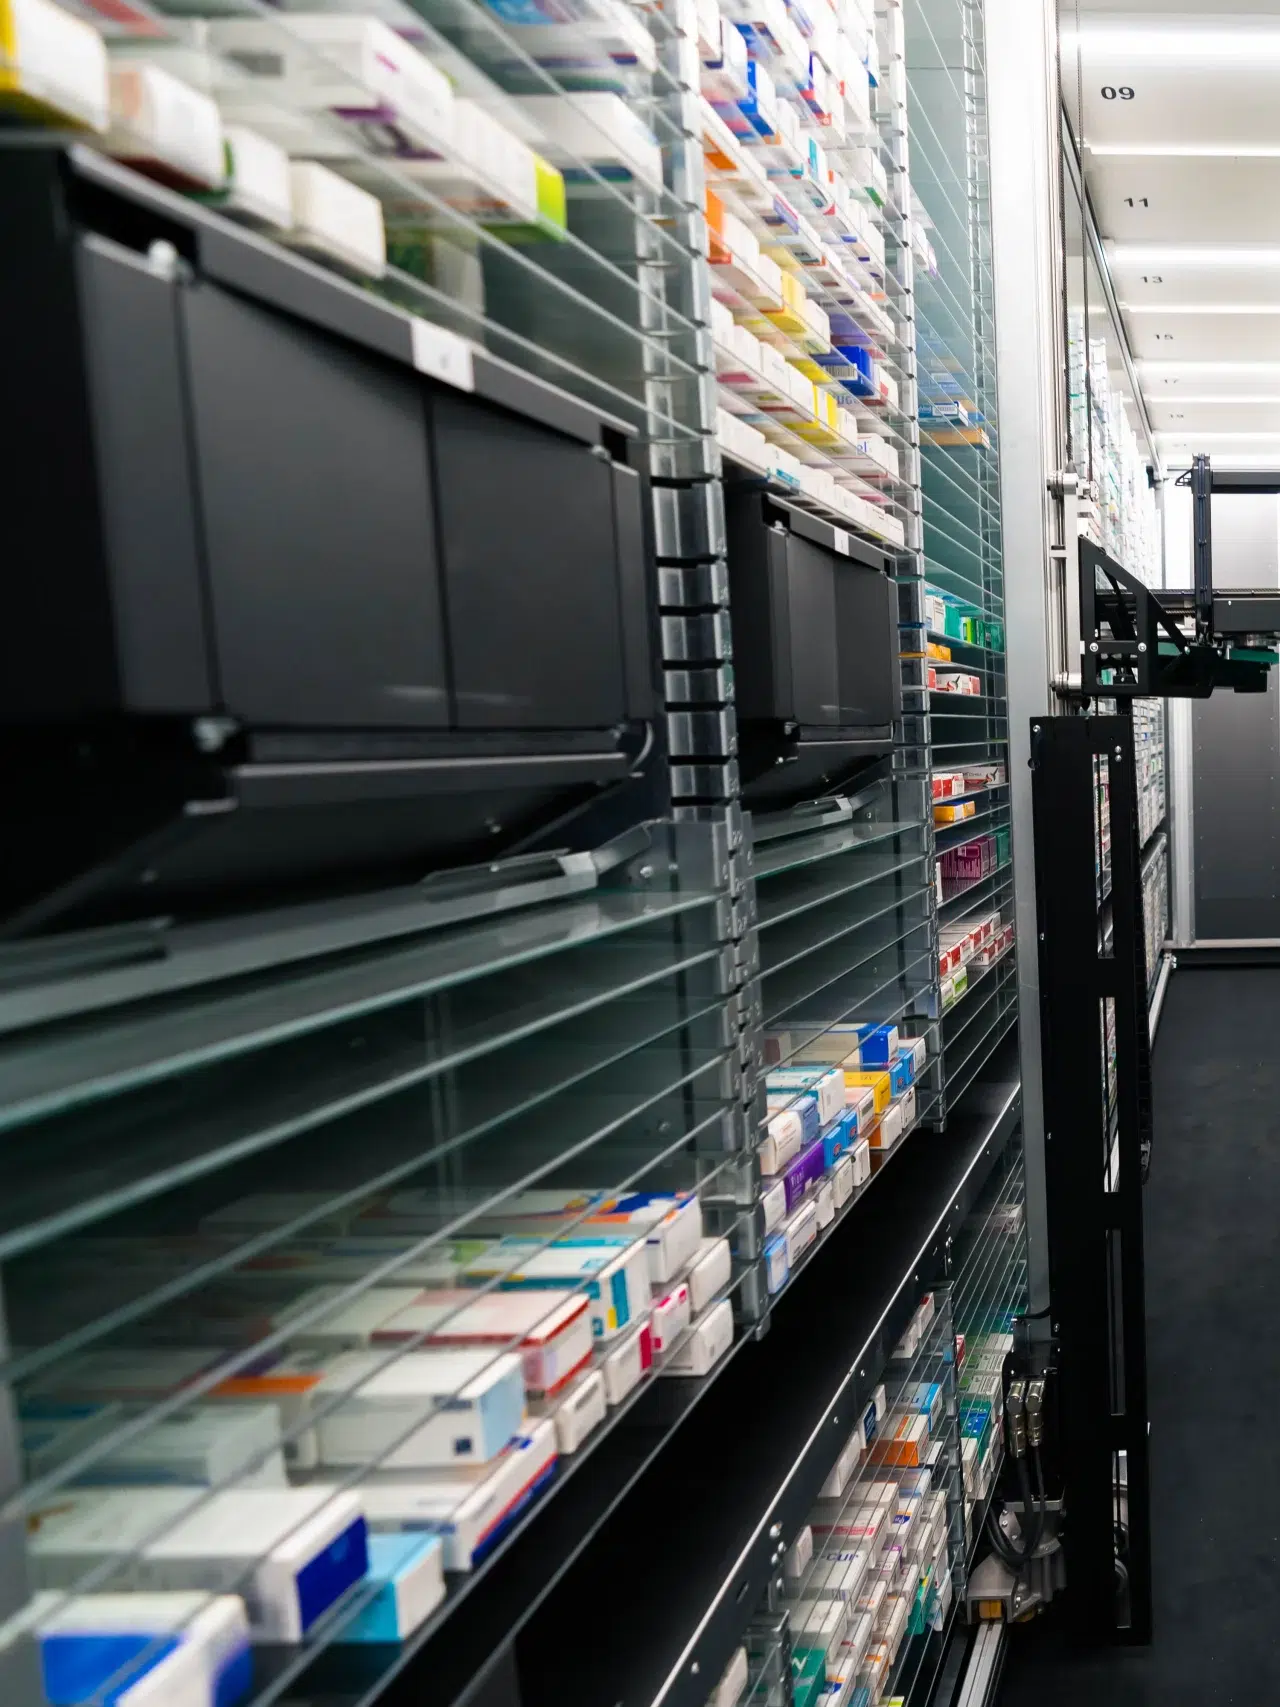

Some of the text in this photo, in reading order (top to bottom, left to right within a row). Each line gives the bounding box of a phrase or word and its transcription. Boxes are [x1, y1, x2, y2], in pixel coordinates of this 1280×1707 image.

[1100, 86, 1135, 101] 09
[1123, 197, 1150, 208] 11
[1140, 275, 1163, 284] 13
